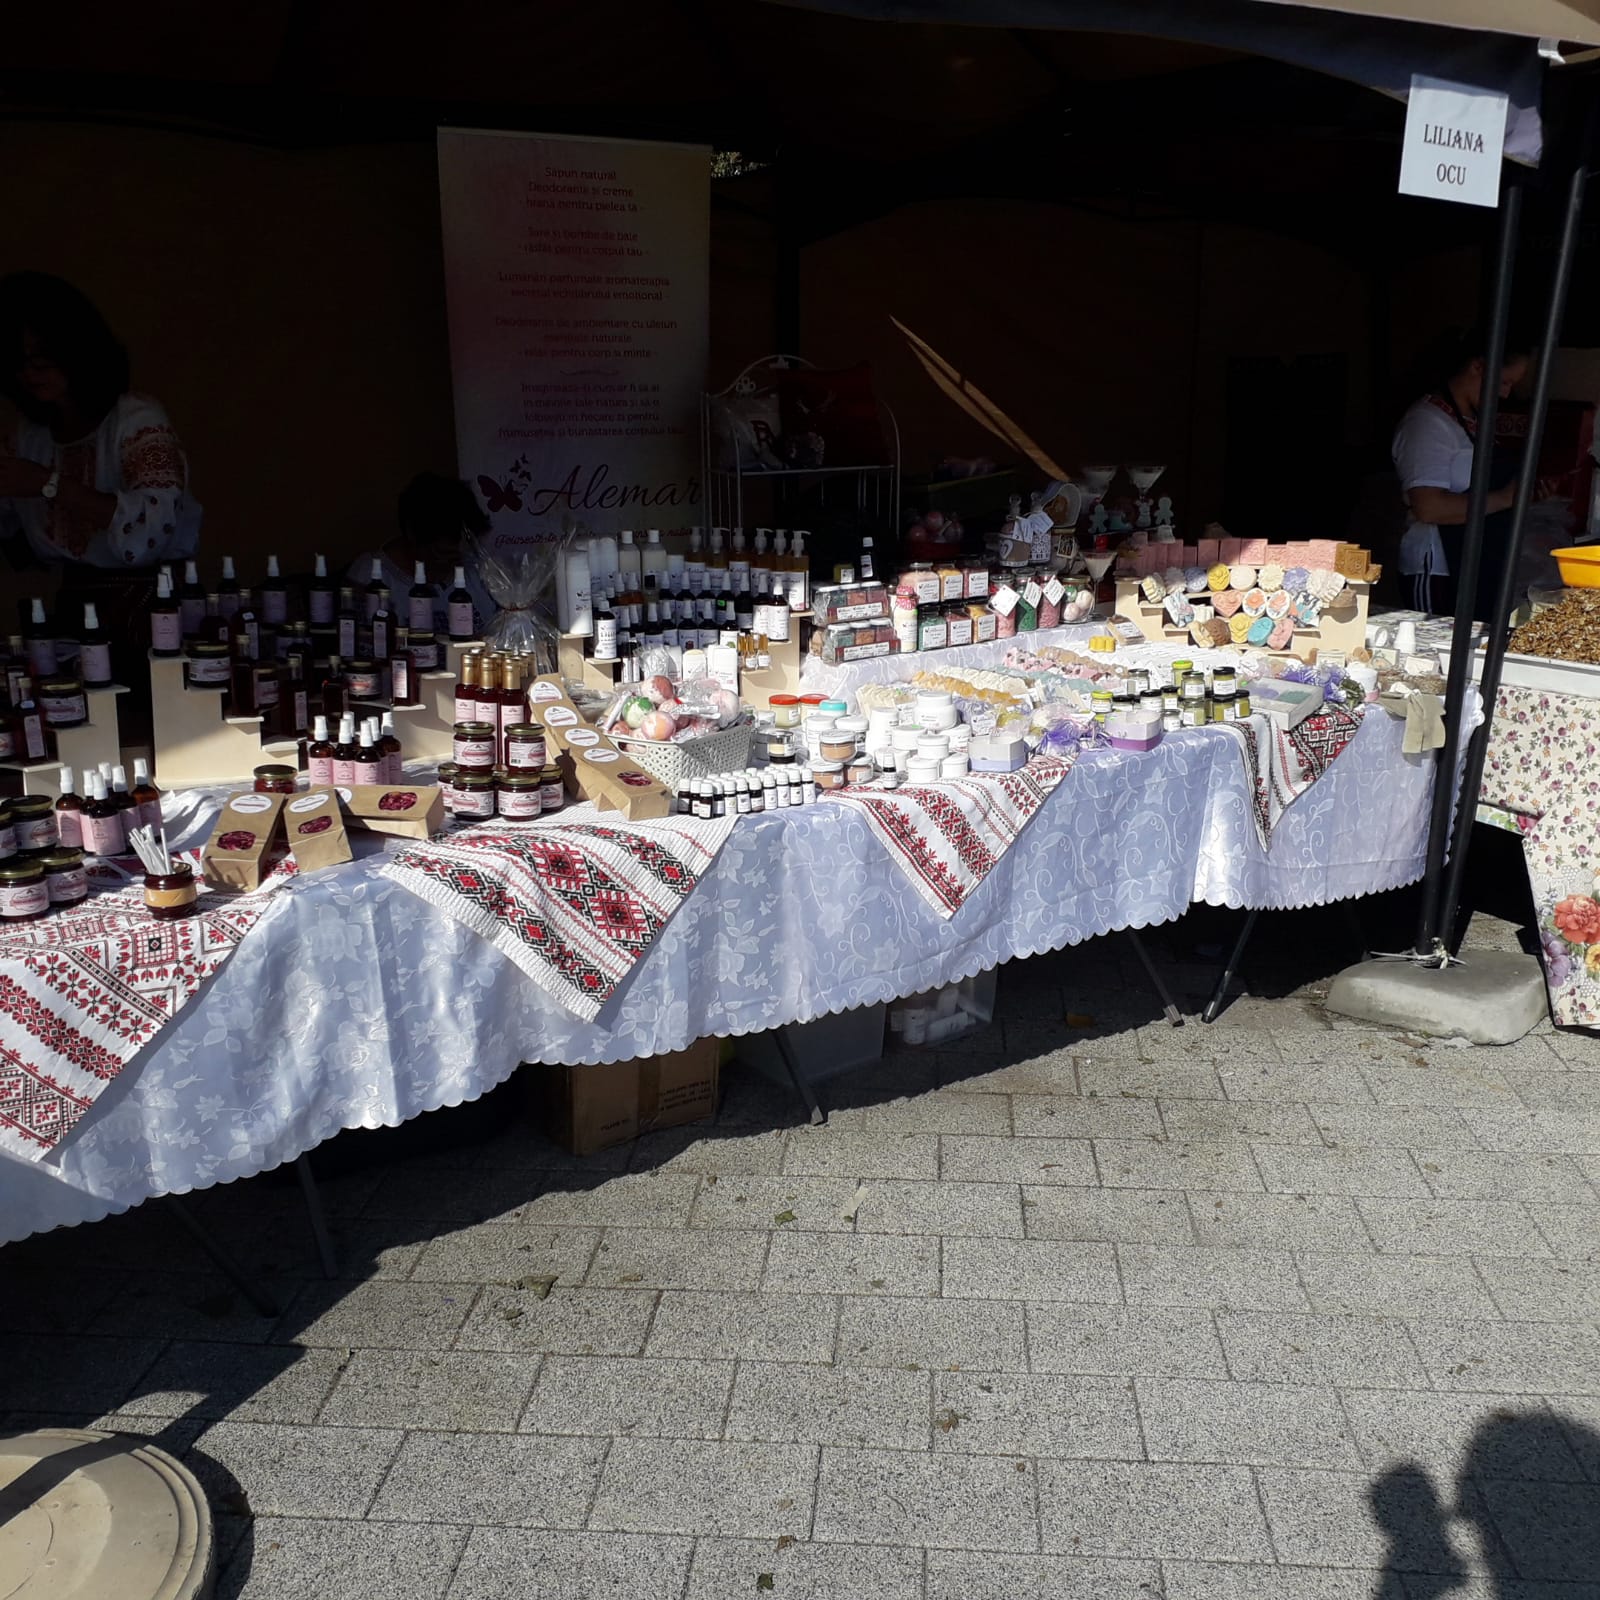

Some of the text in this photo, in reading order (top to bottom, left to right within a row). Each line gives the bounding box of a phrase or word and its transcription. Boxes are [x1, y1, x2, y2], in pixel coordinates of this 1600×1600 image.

[1423, 124, 1484, 153] LILIANA
[581, 169, 616, 181] natural
[1436, 163, 1467, 185] OCU
[602, 187, 633, 198] creme
[528, 463, 699, 515] Alemar
